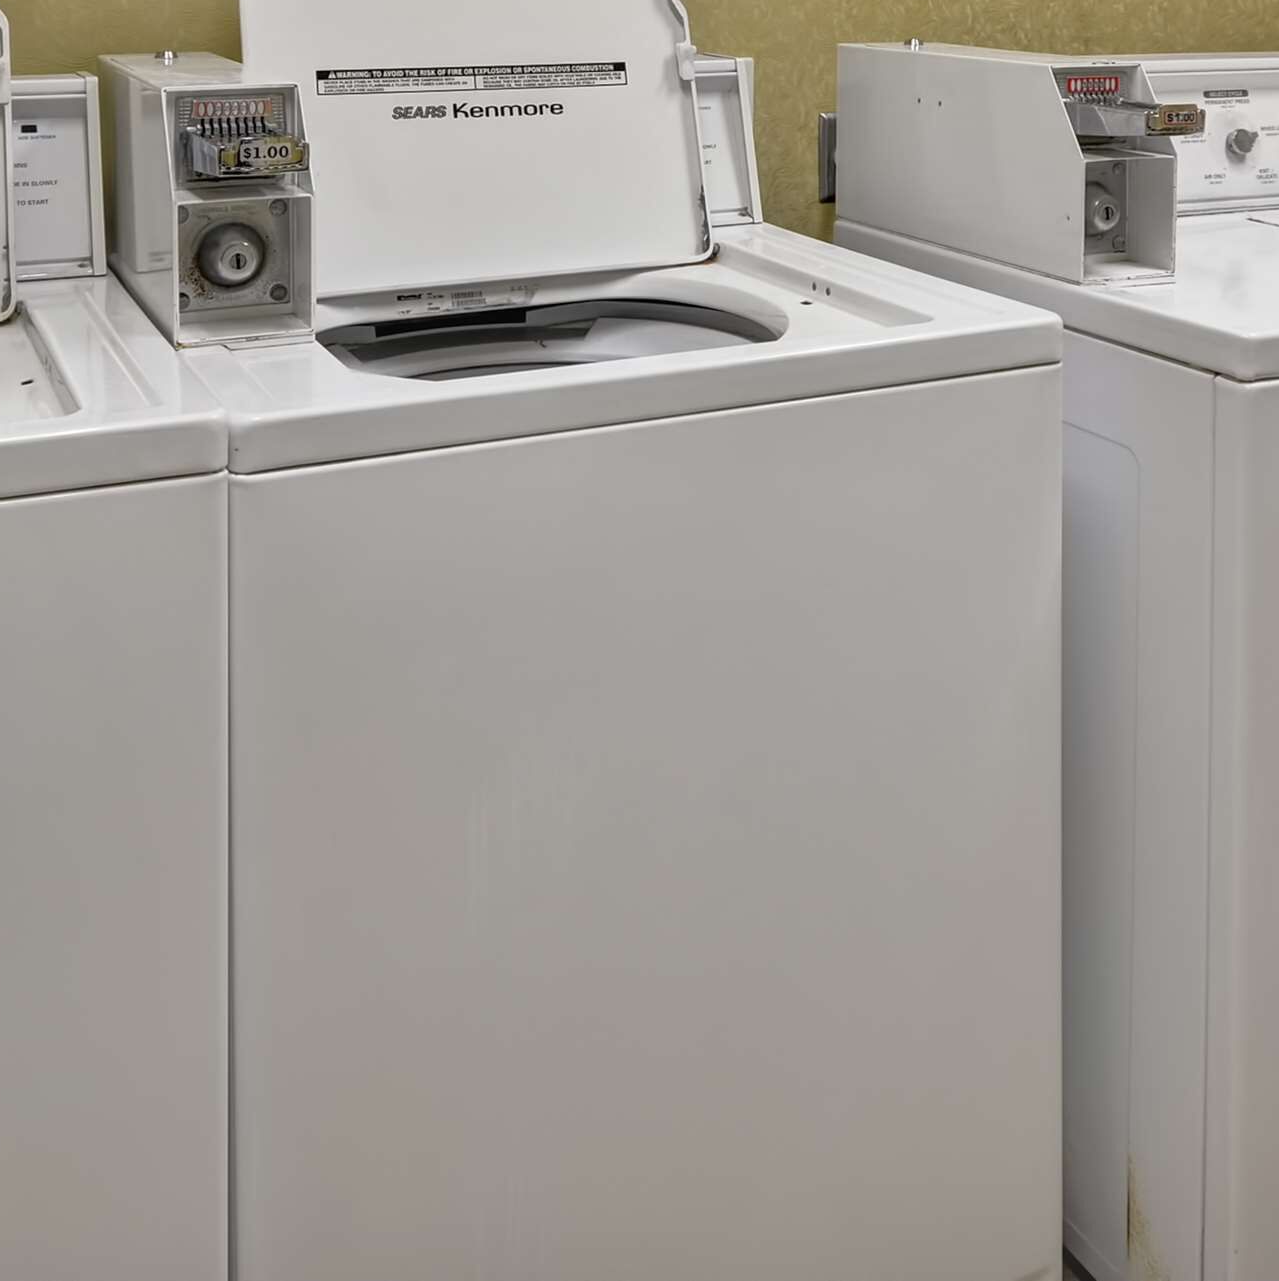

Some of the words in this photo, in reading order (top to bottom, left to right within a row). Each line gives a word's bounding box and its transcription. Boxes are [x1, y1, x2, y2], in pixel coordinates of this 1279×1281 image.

[392, 105, 447, 120] SEARS
[453, 102, 563, 118] Kenmore
[243, 146, 288, 159] $1.00
